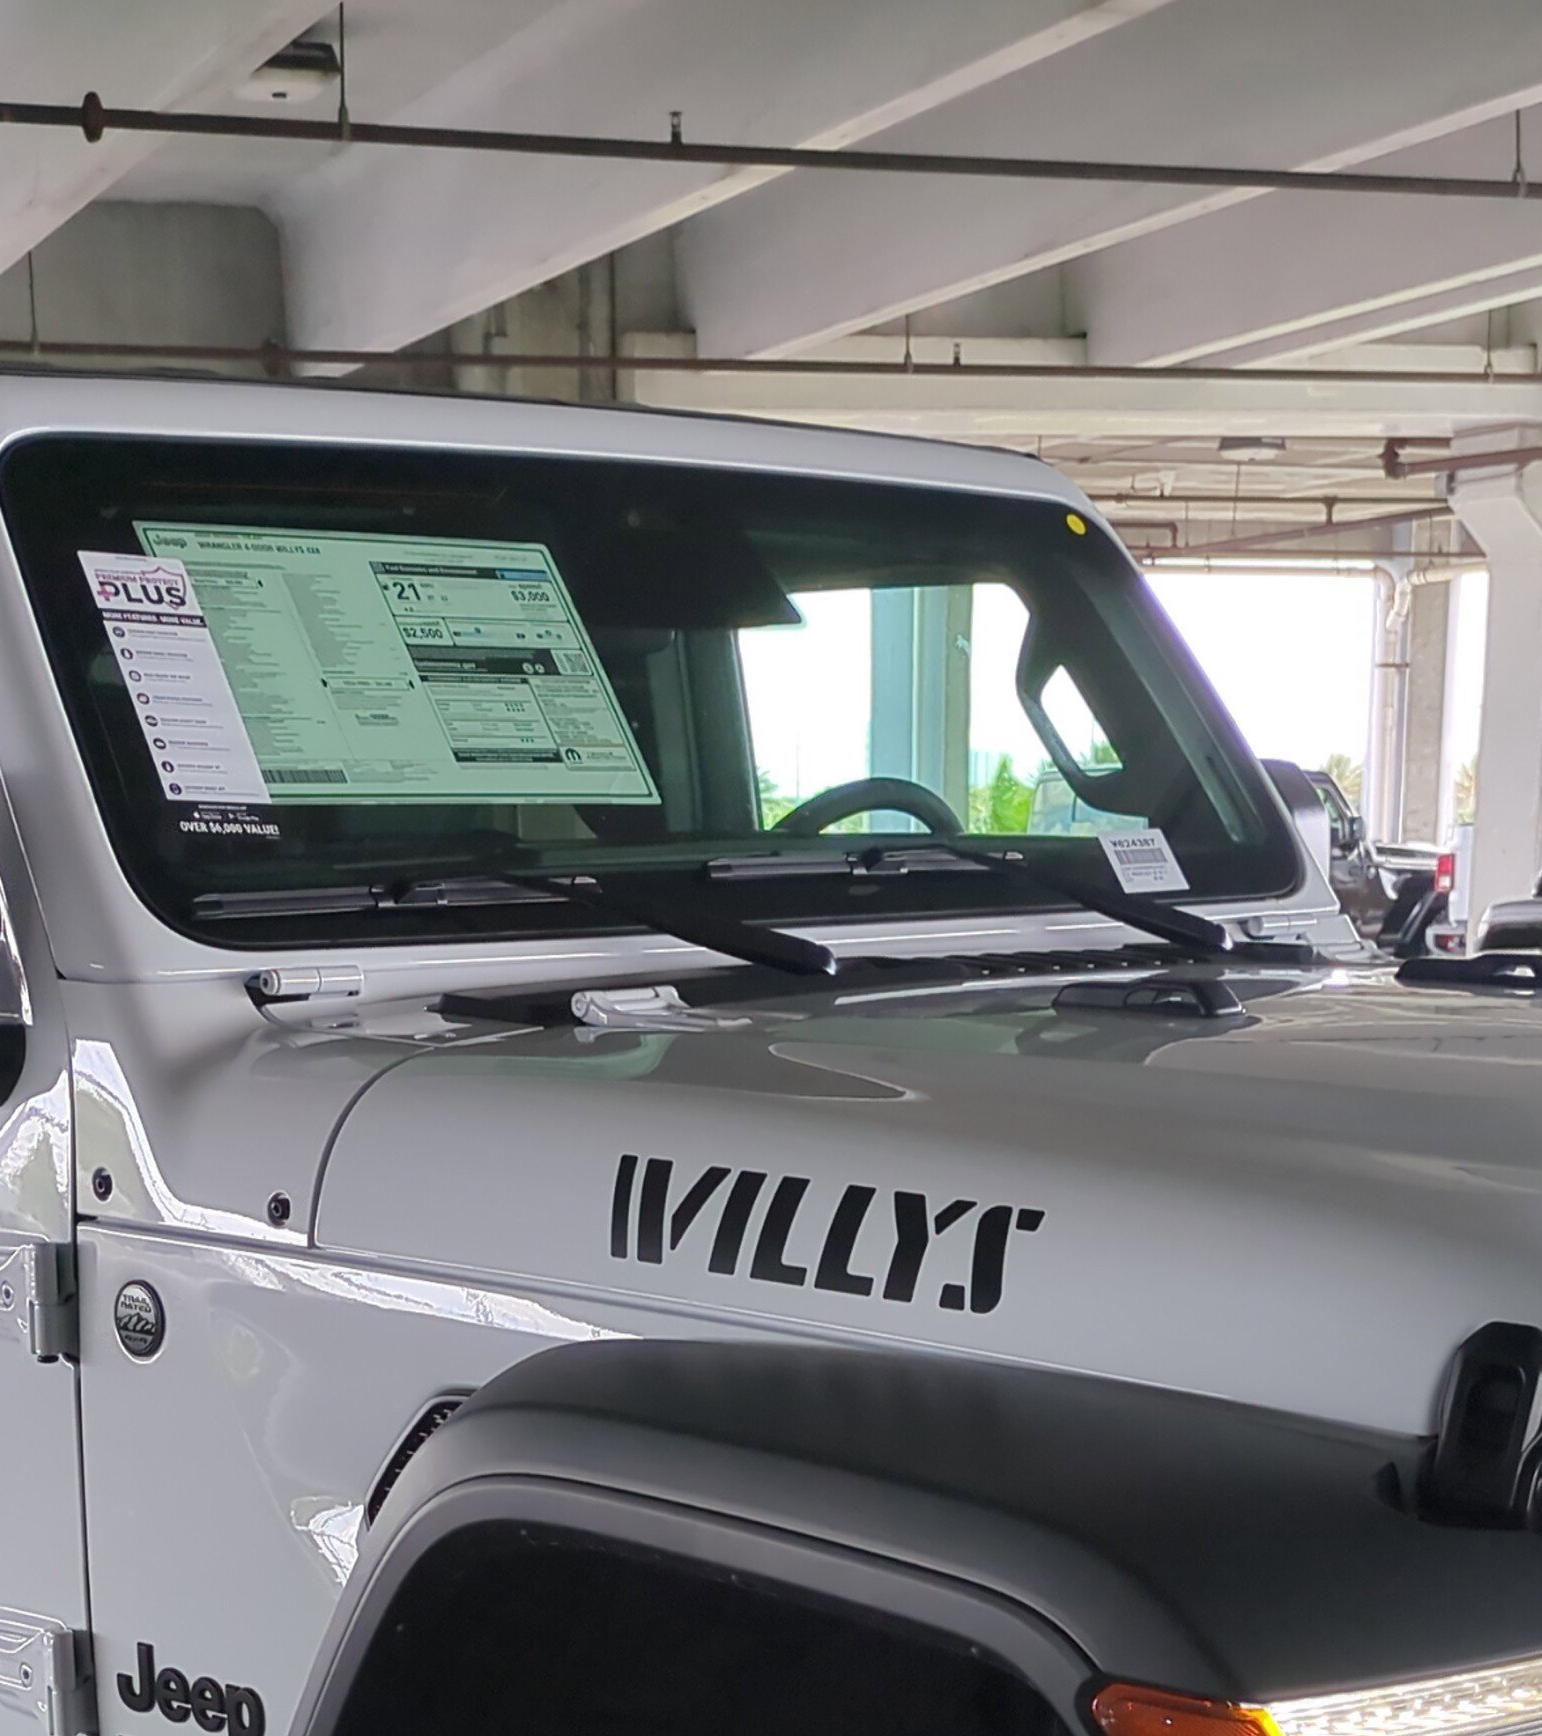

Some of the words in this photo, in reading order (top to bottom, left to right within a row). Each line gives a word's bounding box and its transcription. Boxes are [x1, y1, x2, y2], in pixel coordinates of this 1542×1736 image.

[96, 580, 187, 607] PLUS
[392, 581, 421, 601] 21
[511, 590, 550, 602] $3,000
[402, 627, 444, 639] $2,500
[179, 820, 208, 833] OVER
[209, 822, 242, 835] $6,000
[244, 824, 280, 836] VALUE!
[609, 1153, 1046, 1315] WILLYS
[120, 1300, 152, 1313] RATED
